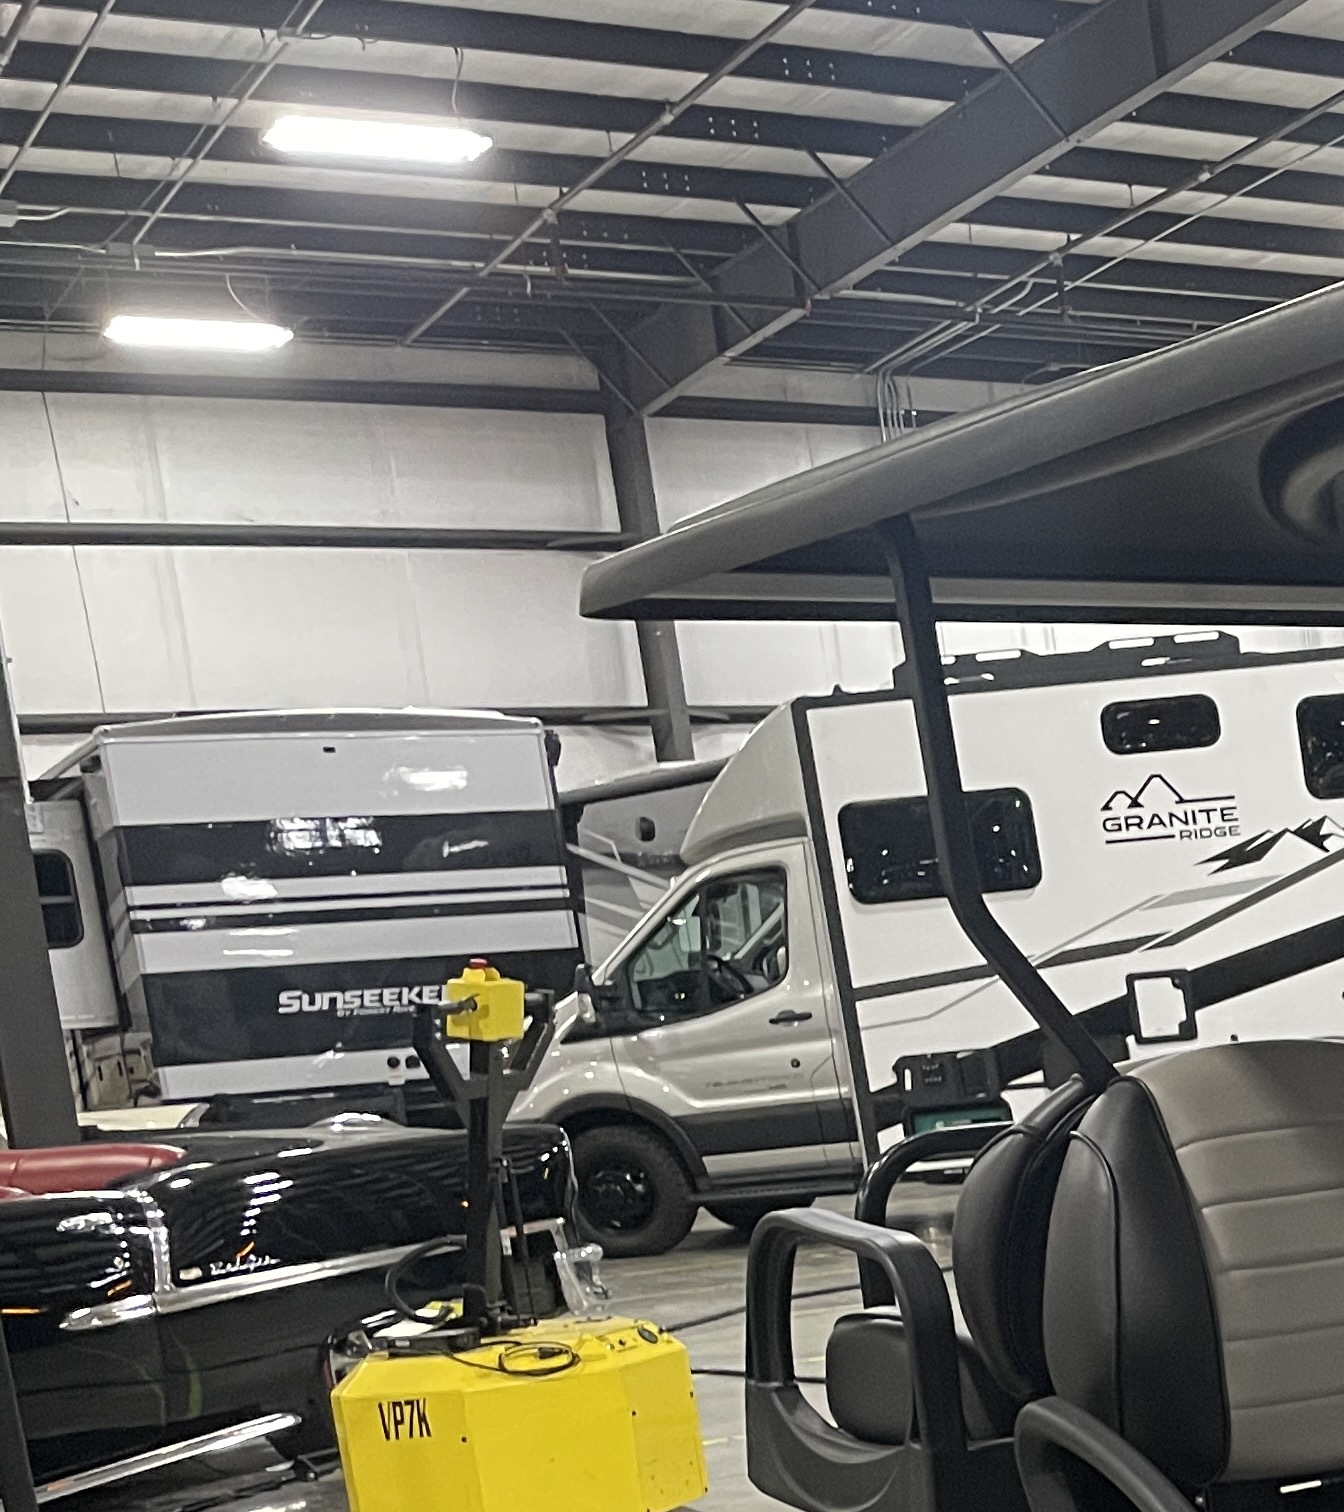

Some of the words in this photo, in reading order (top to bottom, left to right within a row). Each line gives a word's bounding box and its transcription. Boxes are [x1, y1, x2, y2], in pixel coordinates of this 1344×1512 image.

[1102, 805, 1239, 833] GRANITE
[1179, 824, 1241, 841] RIDGE
[278, 984, 447, 1014] SUNSEEKE
[377, 1397, 432, 1441] VP7K
